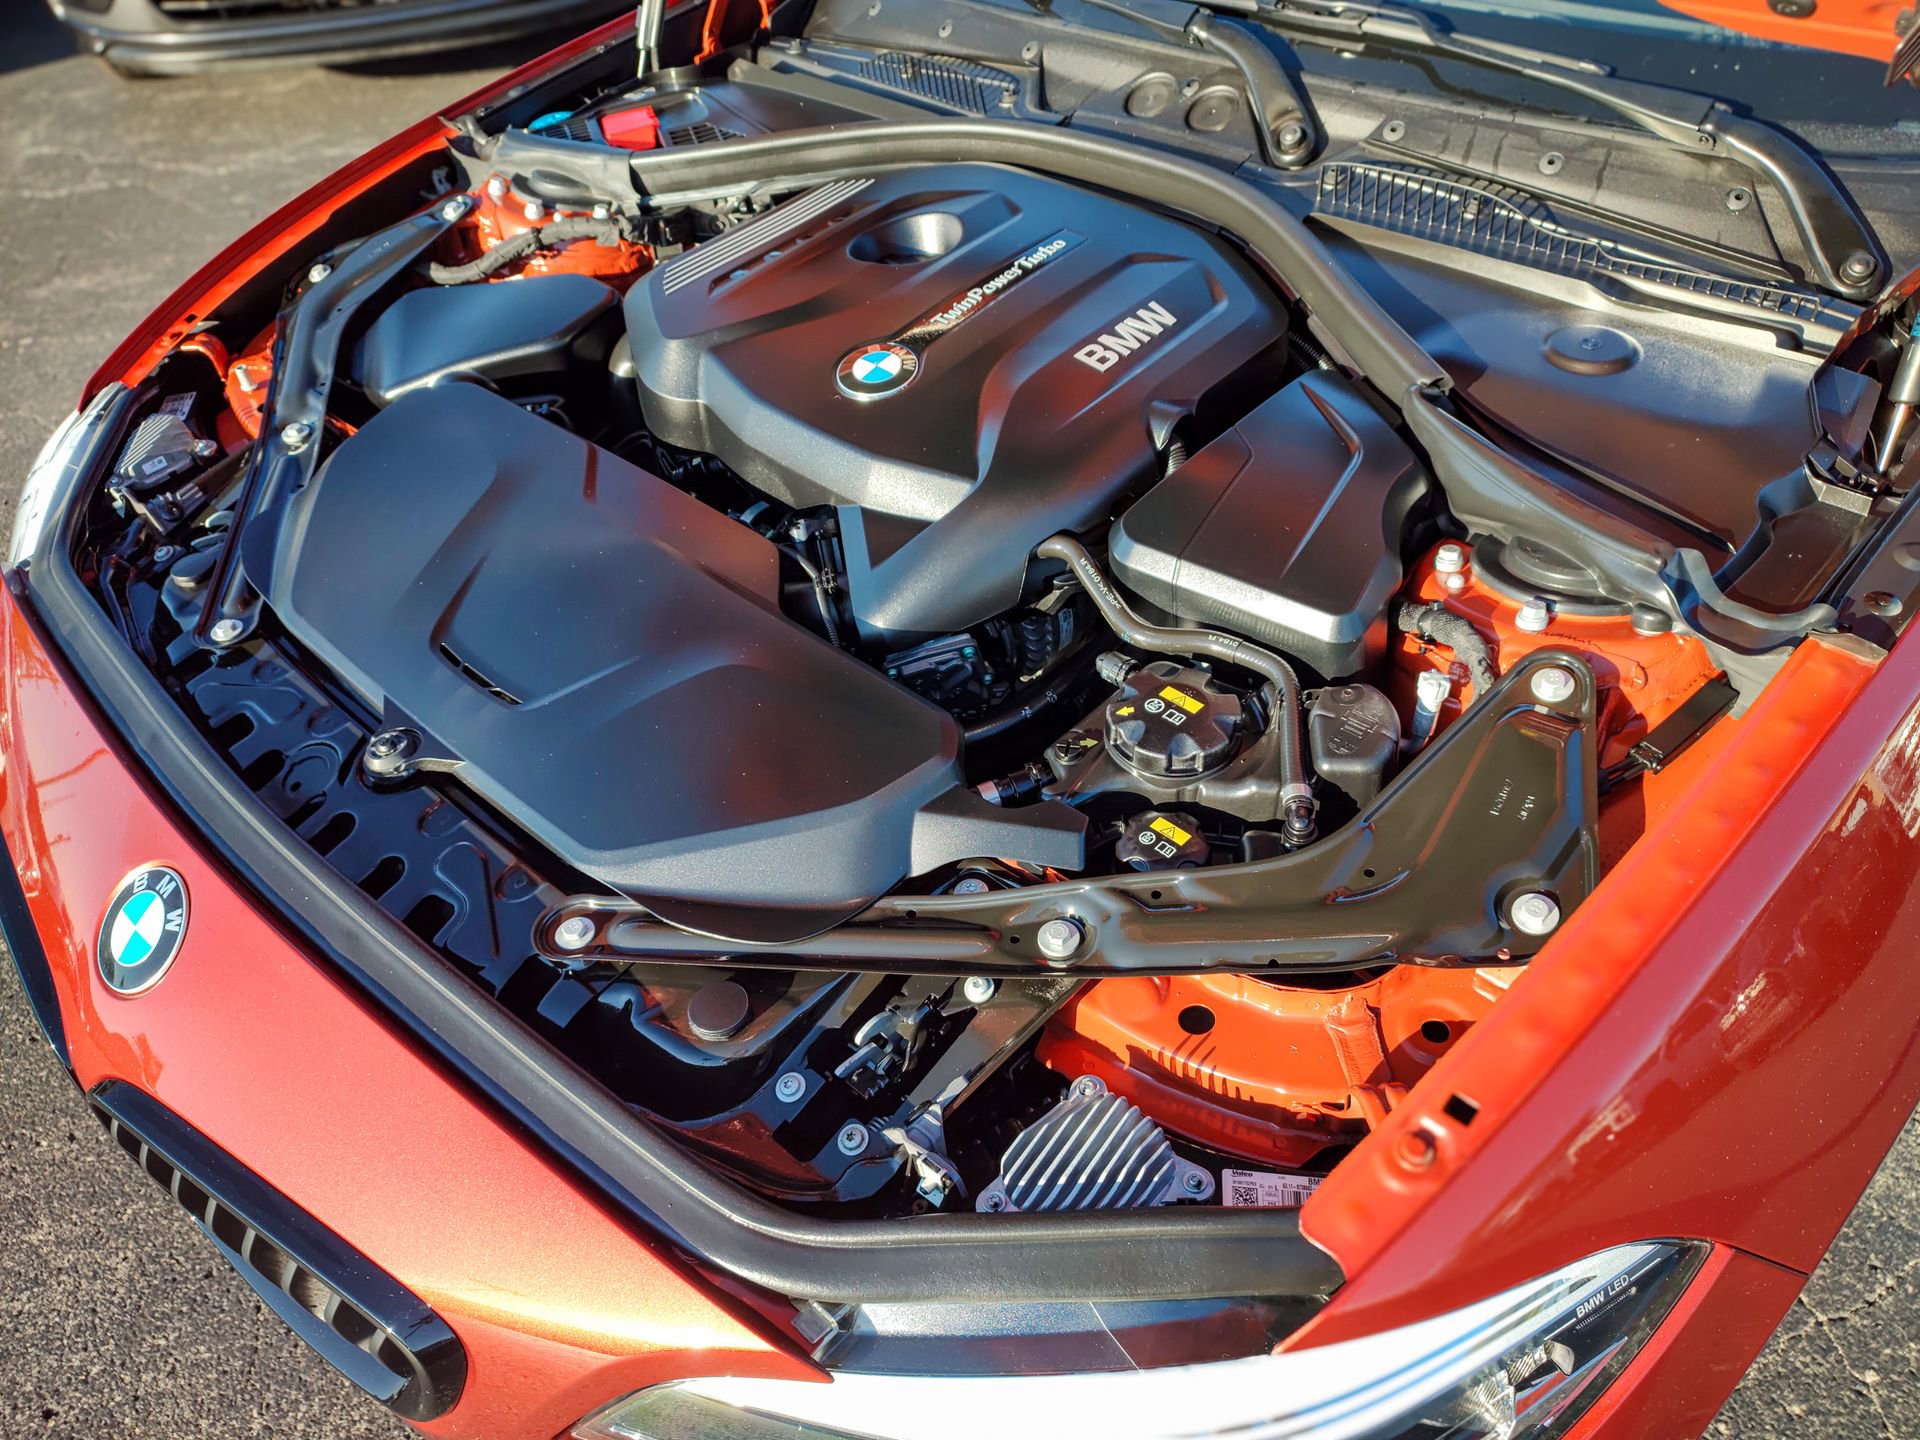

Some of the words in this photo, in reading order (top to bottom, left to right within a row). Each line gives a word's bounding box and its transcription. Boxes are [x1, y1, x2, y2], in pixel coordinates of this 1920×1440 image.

[930, 239, 1067, 326] TwinPowerTurbo
[1073, 300, 1178, 374] BMW
[132, 872, 184, 933] BMW
[1231, 1169, 1254, 1178] Valeo
[1575, 1290, 1606, 1318] BMW
[1607, 1274, 1630, 1296] LED
